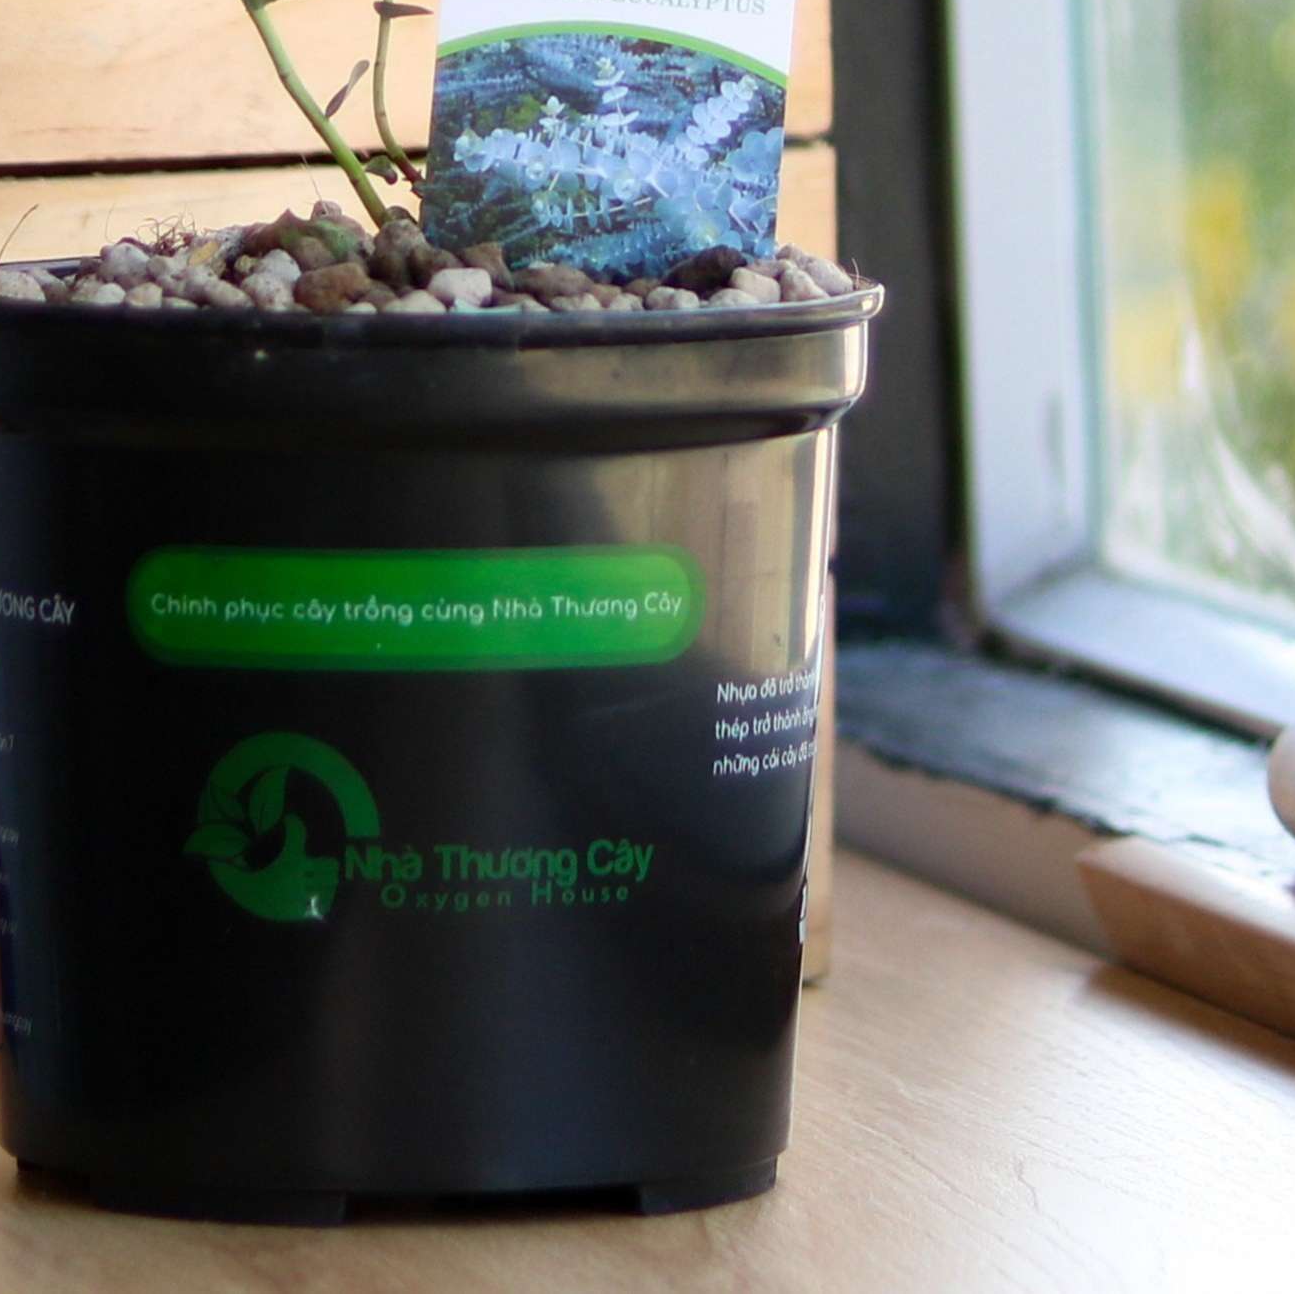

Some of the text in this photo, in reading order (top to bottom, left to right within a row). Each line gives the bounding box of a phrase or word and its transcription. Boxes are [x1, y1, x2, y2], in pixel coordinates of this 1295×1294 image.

[38, 593, 76, 626] CÂY
[224, 598, 285, 623] phục
[293, 598, 336, 624] cây
[343, 595, 413, 626] trồng
[421, 597, 484, 626] cùng
[492, 598, 543, 619] Nhà
[551, 595, 637, 620] Thương
[644, 591, 682, 617] Cây
[717, 682, 757, 705] Nhựa
[715, 717, 749, 741] thép
[713, 753, 760, 777] những
[344, 838, 655, 887] Nhà Thương Cây
[381, 882, 630, 913] Oxygen House
